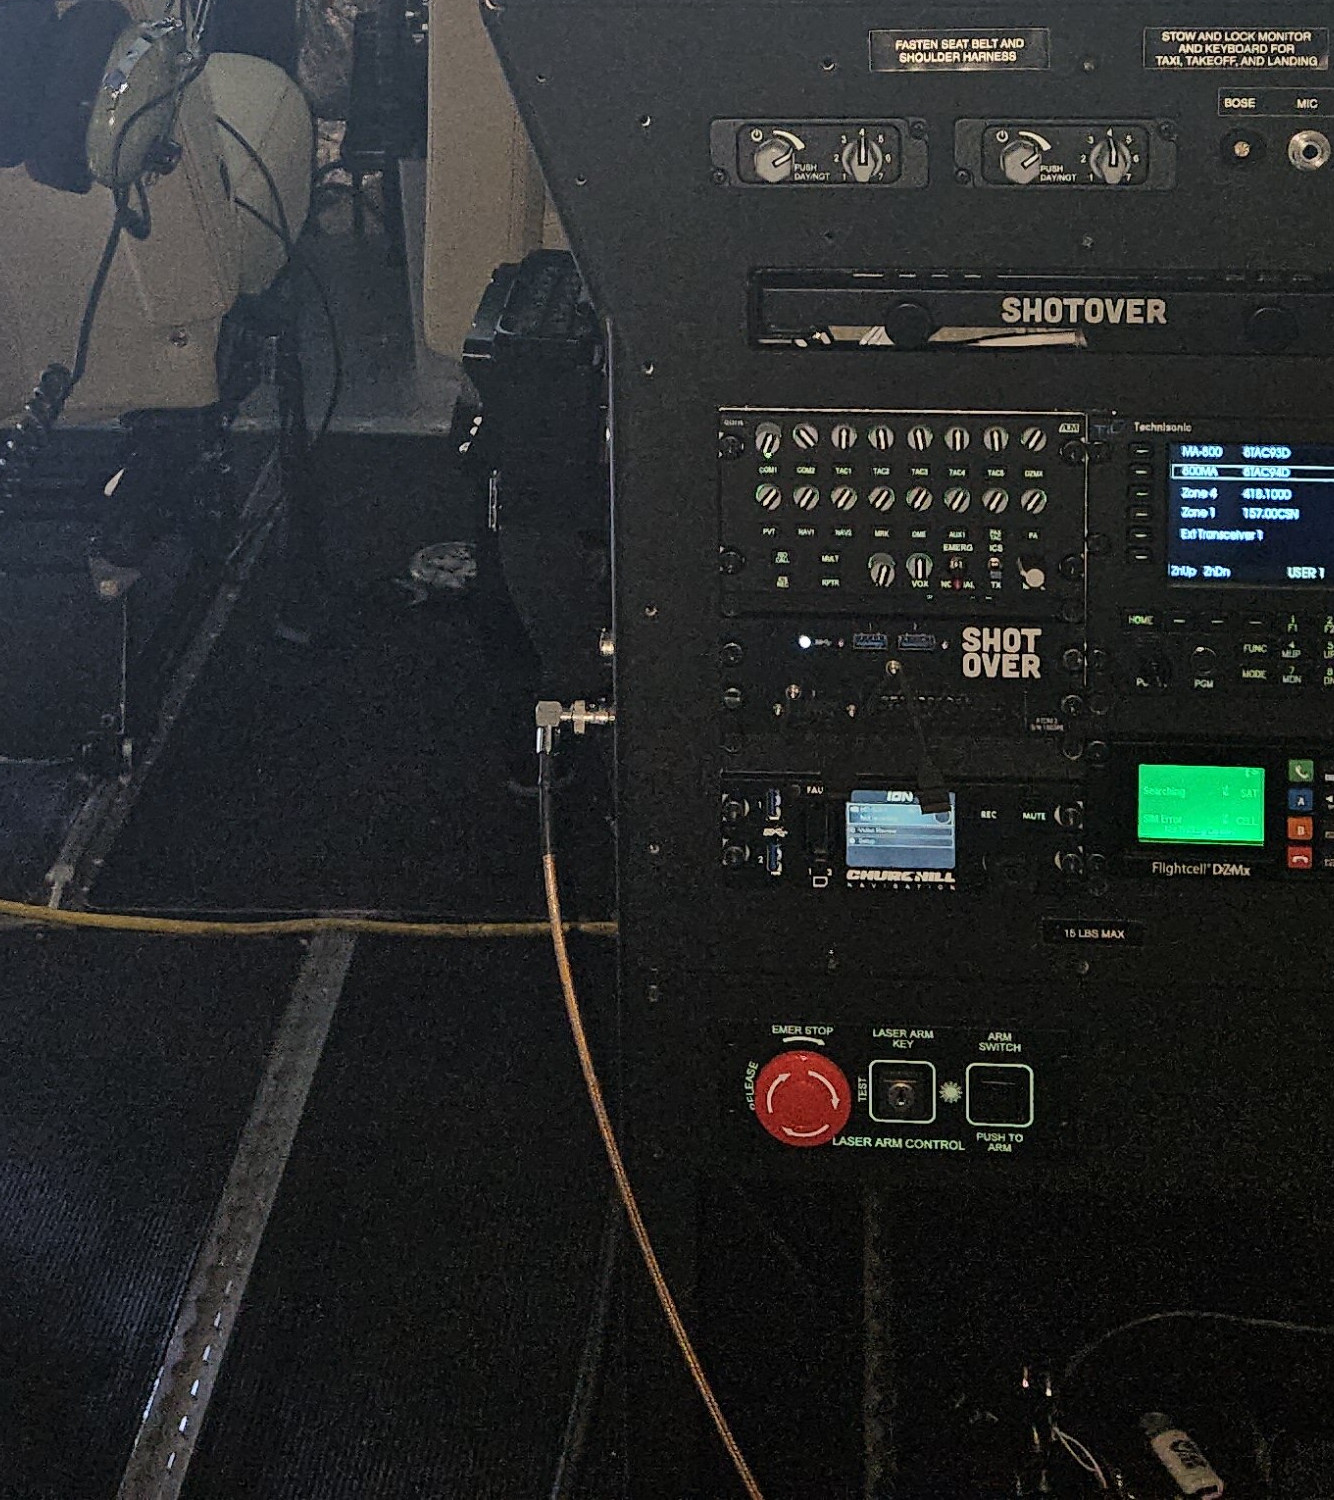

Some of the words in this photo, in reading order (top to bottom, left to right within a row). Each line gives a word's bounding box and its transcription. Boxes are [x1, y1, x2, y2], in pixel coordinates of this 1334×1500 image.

[1161, 31, 1195, 42] STOW
[1197, 31, 1222, 42] AND
[1224, 31, 1255, 42] LOCK
[1257, 31, 1312, 42] MONITOR
[895, 40, 939, 50] FASTEN
[941, 39, 971, 50] SEAT
[972, 39, 998, 49] BELT
[1000, 39, 1025, 49] AND
[1178, 44, 1203, 54] AND
[1204, 44, 1268, 54] KEYBOARD
[1270, 44, 1295, 54] FOR
[899, 52, 961, 63] SHOULDER
[963, 51, 1017, 62] HARNESS
[1155, 56, 1183, 67] TAXI,
[1185, 56, 1239, 67] TAKEOFF,
[1240, 56, 1265, 67] AND
[1267, 56, 1319, 67] LANDING
[1224, 98, 1256, 108] BOSE
[1296, 98, 1318, 109] MIC
[1040, 165, 1064, 173] PUSH
[1001, 296, 1167, 325] SHOTOVER
[1134, 422, 1192, 432] Technisonic
[1286, 566, 1317, 580] USER
[1318, 567, 1325, 580] 1
[911, 580, 929, 588] VOX
[961, 627, 1042, 653] SHOT
[962, 652, 1042, 678] OVER
[980, 811, 997, 819] REC
[1023, 812, 1046, 821] MUTE
[1078, 929, 1099, 938] LBS
[1101, 929, 1125, 939] MAX
[772, 1025, 803, 1035] EMER
[805, 1025, 834, 1036] STOP
[872, 1028, 907, 1039] LASER
[910, 1029, 934, 1040] ARM
[987, 1032, 1012, 1042] ARM
[892, 1040, 914, 1049] KEY
[978, 1042, 1021, 1053] SWITCH
[858, 1077, 867, 1103] TEST
[977, 1132, 1005, 1142] PUSH
[1008, 1133, 1024, 1143] TO
[832, 1136, 872, 1147] LASER
[875, 1137, 902, 1148] ARM
[905, 1138, 965, 1151] CONTROL
[987, 1143, 1012, 1152] ARM
